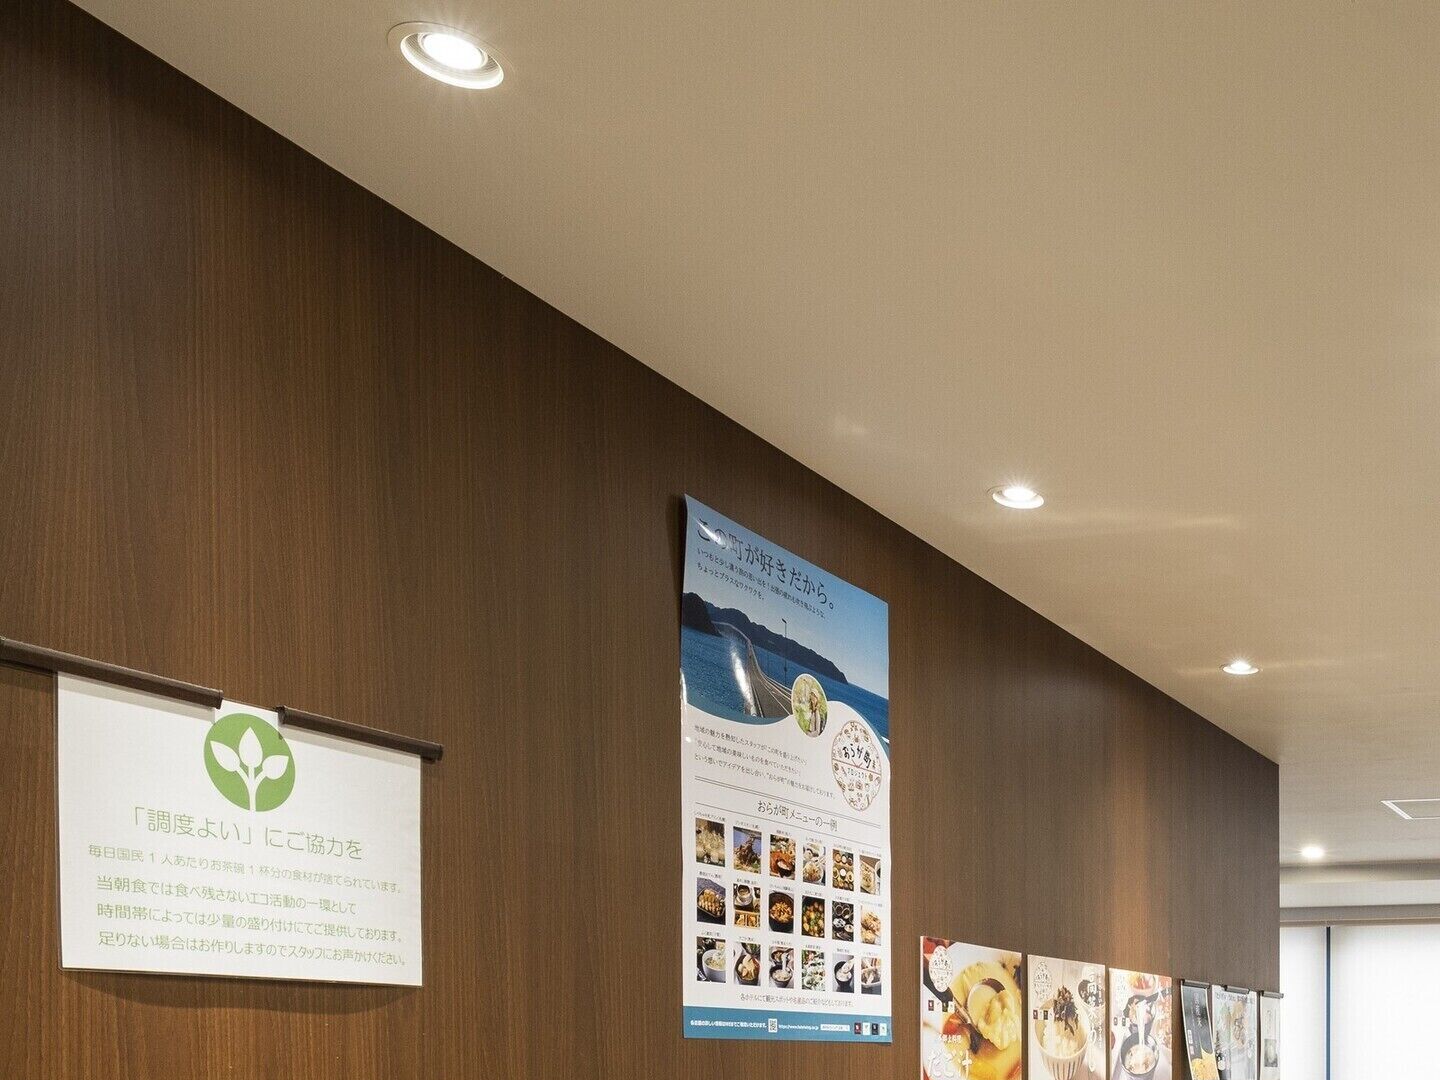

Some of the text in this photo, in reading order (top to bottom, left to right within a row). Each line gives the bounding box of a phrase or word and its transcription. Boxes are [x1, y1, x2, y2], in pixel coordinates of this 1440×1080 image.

[697, 517, 834, 610] この町が好きだから。
[133, 806, 363, 860] 「調度よい」にご協力を
[757, 800, 838, 832] おらが町メニューの一例
[96, 875, 357, 915] 当朝食では食べ残さないエコ活動の一環として
